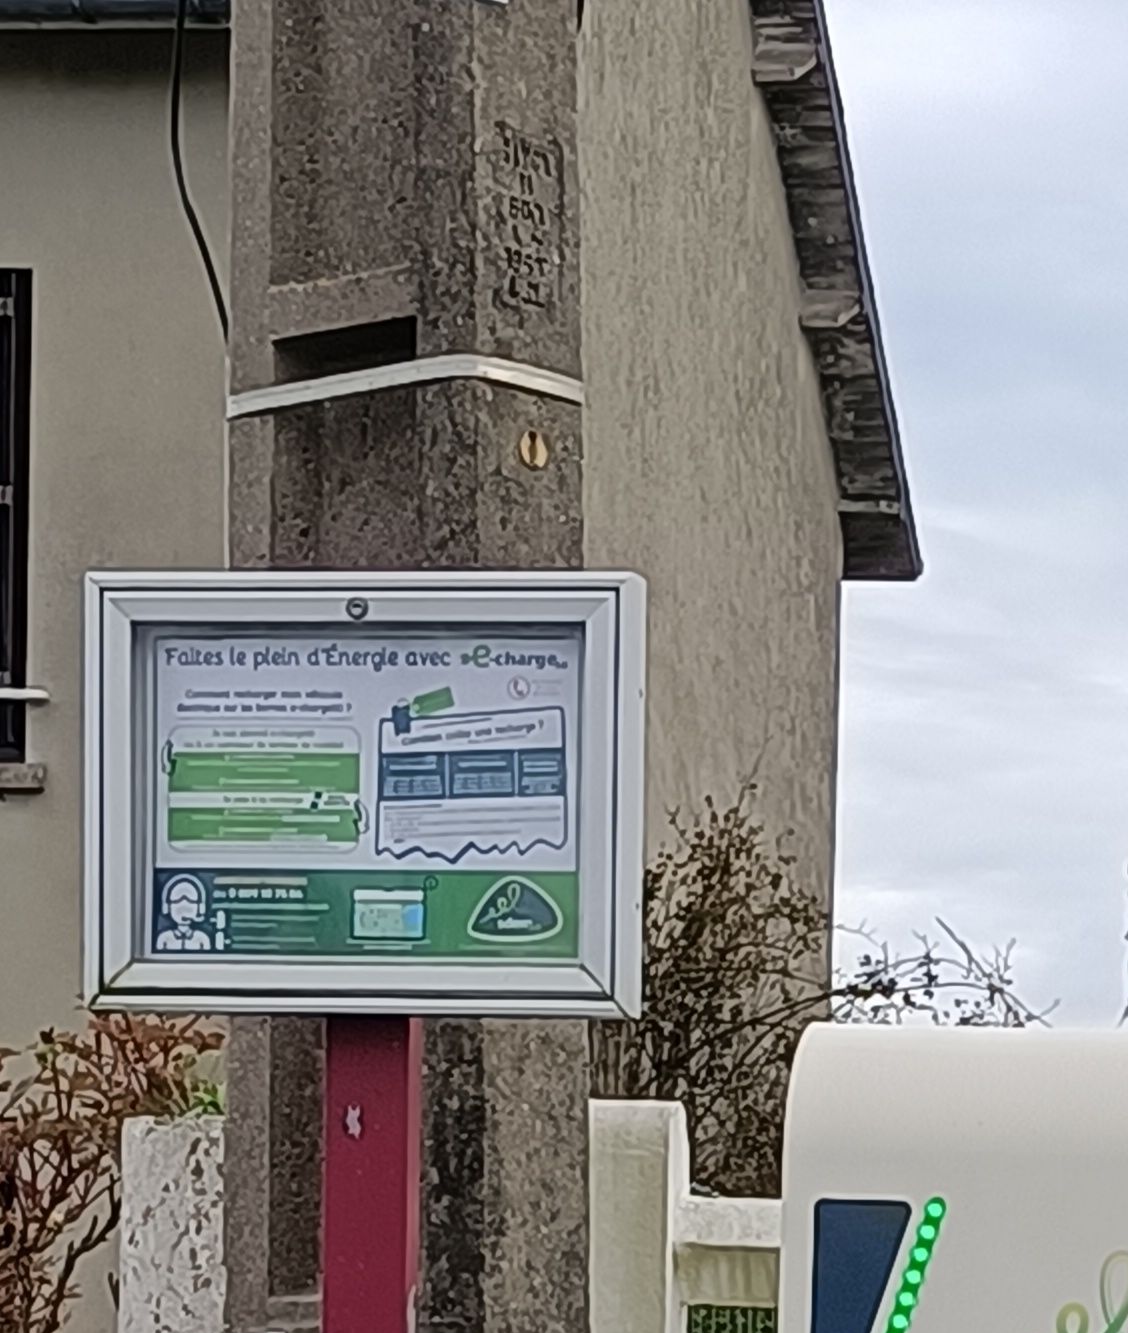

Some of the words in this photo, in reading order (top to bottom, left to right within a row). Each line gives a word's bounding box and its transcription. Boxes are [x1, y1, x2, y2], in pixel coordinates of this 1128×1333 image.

[165, 647, 224, 667] Faites
[229, 646, 247, 667] le
[253, 646, 300, 671] plein
[405, 650, 452, 667] avec
